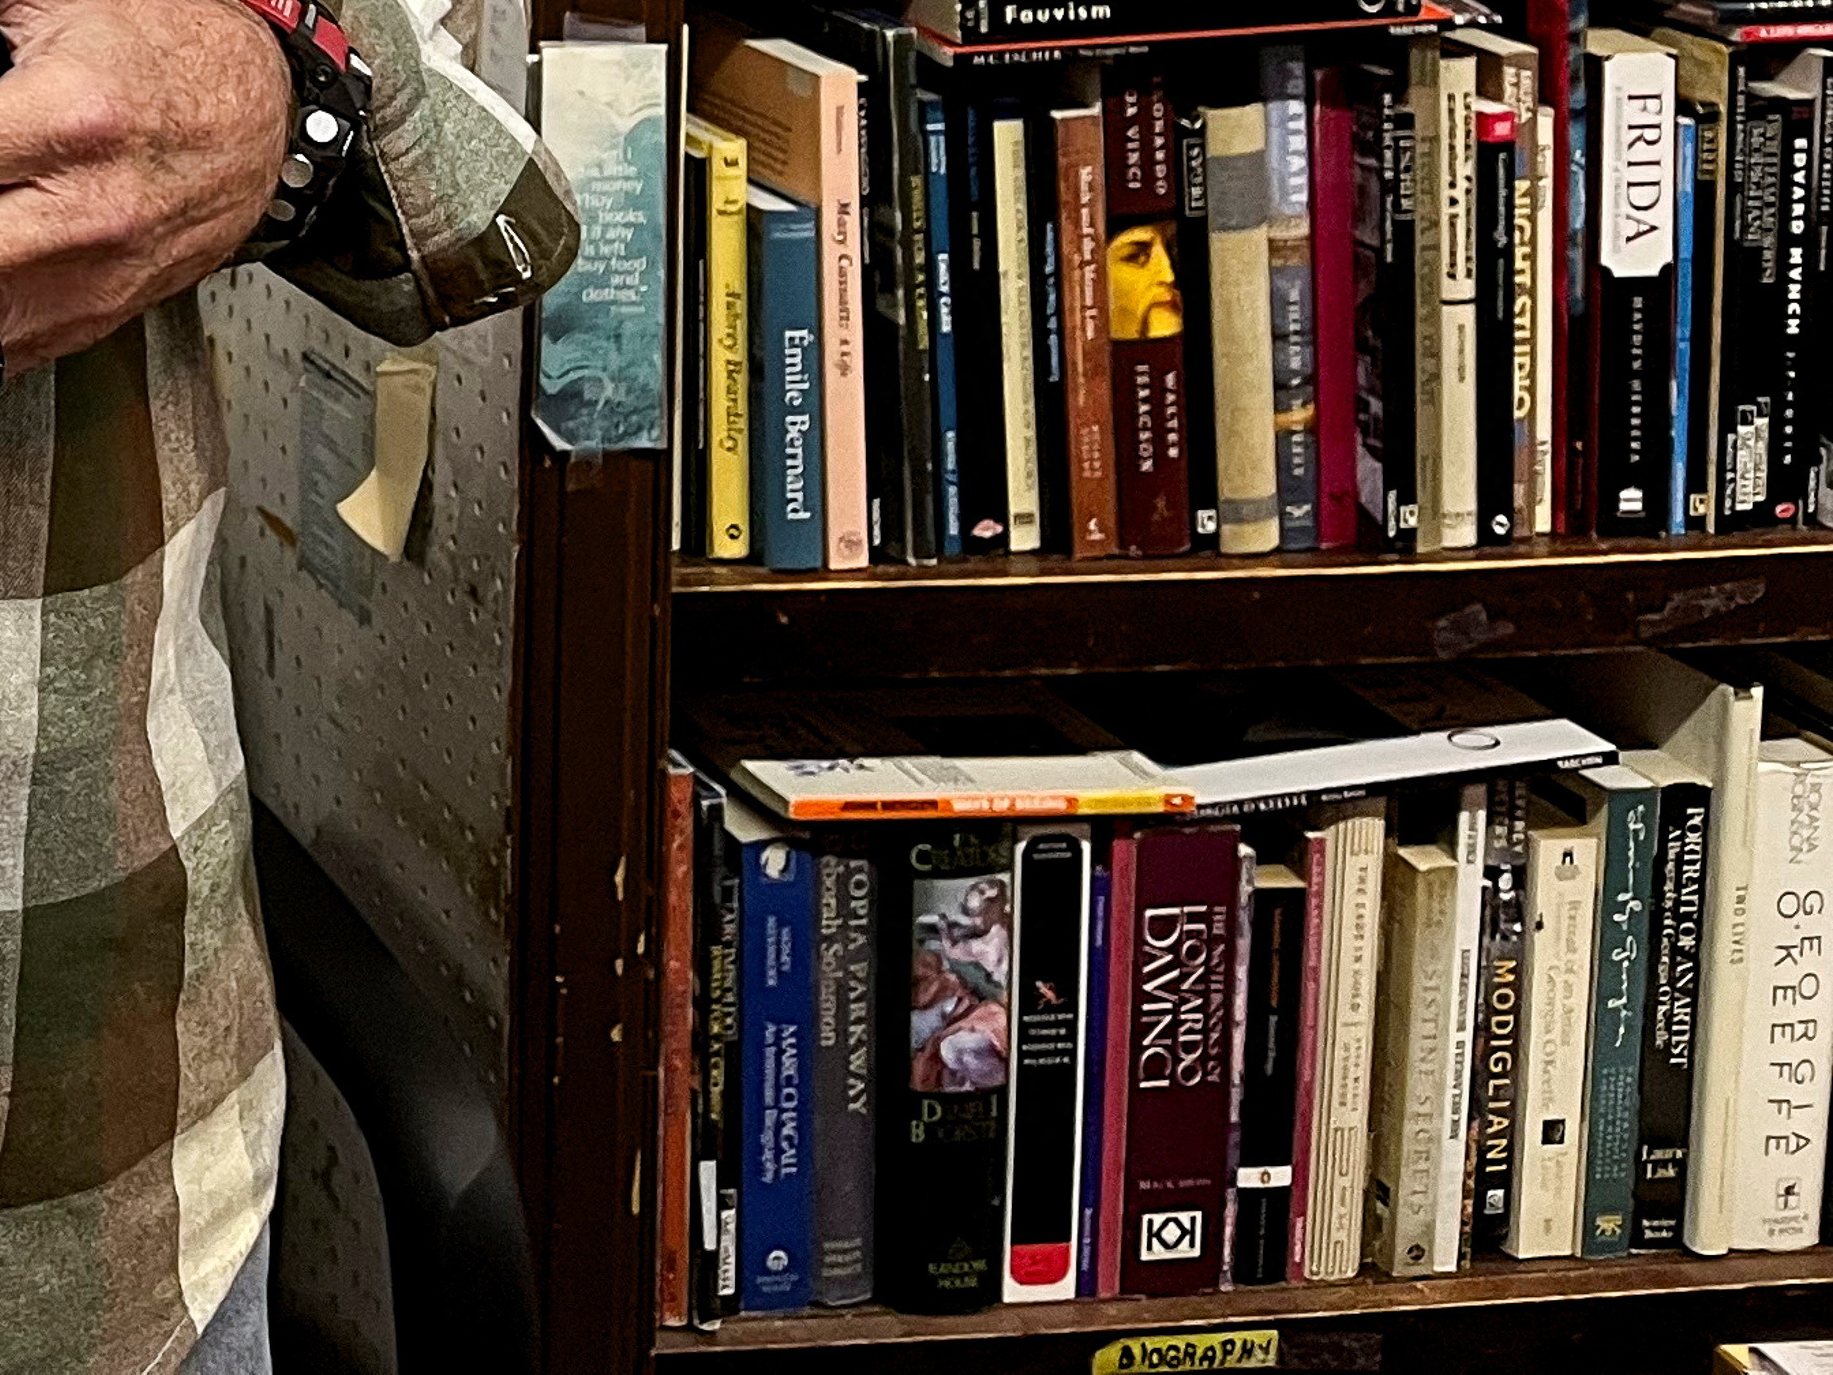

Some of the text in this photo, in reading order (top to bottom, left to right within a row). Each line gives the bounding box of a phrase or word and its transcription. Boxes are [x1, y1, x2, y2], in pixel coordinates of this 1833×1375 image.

[1003, 0, 1112, 25] Fauvism
[1125, 125, 1141, 189] VINCI
[1624, 92, 1663, 245] FRIDA
[1790, 137, 1808, 235] EDVARD
[783, 328, 815, 521] Émile Bernard
[1164, 370, 1180, 460] WALTER
[1176, 905, 1208, 1088] LEONARDO
[1668, 807, 1705, 1069] PORTRAIT OF AN ARTIST
[846, 960, 868, 1116] PARKWAY
[1485, 959, 1516, 1174] MODIGLIANI
[1790, 890, 1824, 1157] GEORGIA
[1119, 1327, 1277, 1370] BIOGRAPHY
